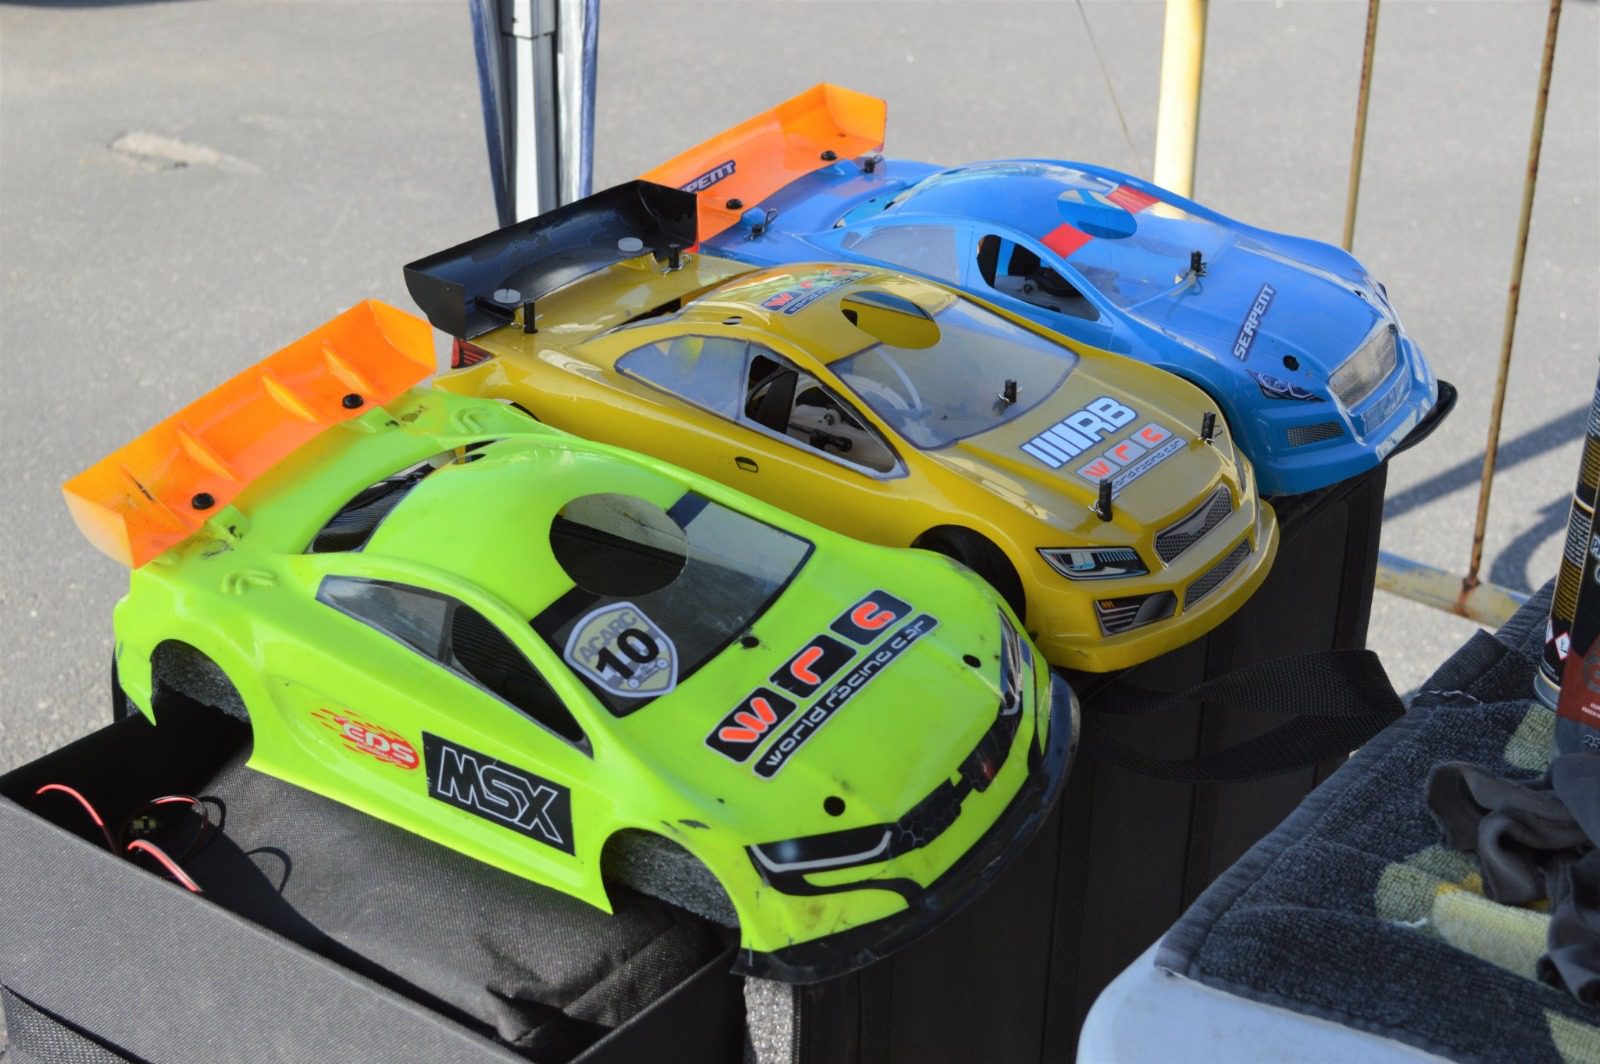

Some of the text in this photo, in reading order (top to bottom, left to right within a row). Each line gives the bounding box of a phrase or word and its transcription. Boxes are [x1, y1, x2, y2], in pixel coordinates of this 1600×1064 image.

[1233, 284, 1274, 361] SERPENT
[1164, 440, 1181, 454] car
[581, 611, 637, 662] ACARC
[596, 628, 660, 680] 10
[766, 619, 925, 767] world racing car
[344, 724, 415, 763] EDS
[437, 745, 564, 845] MSX
